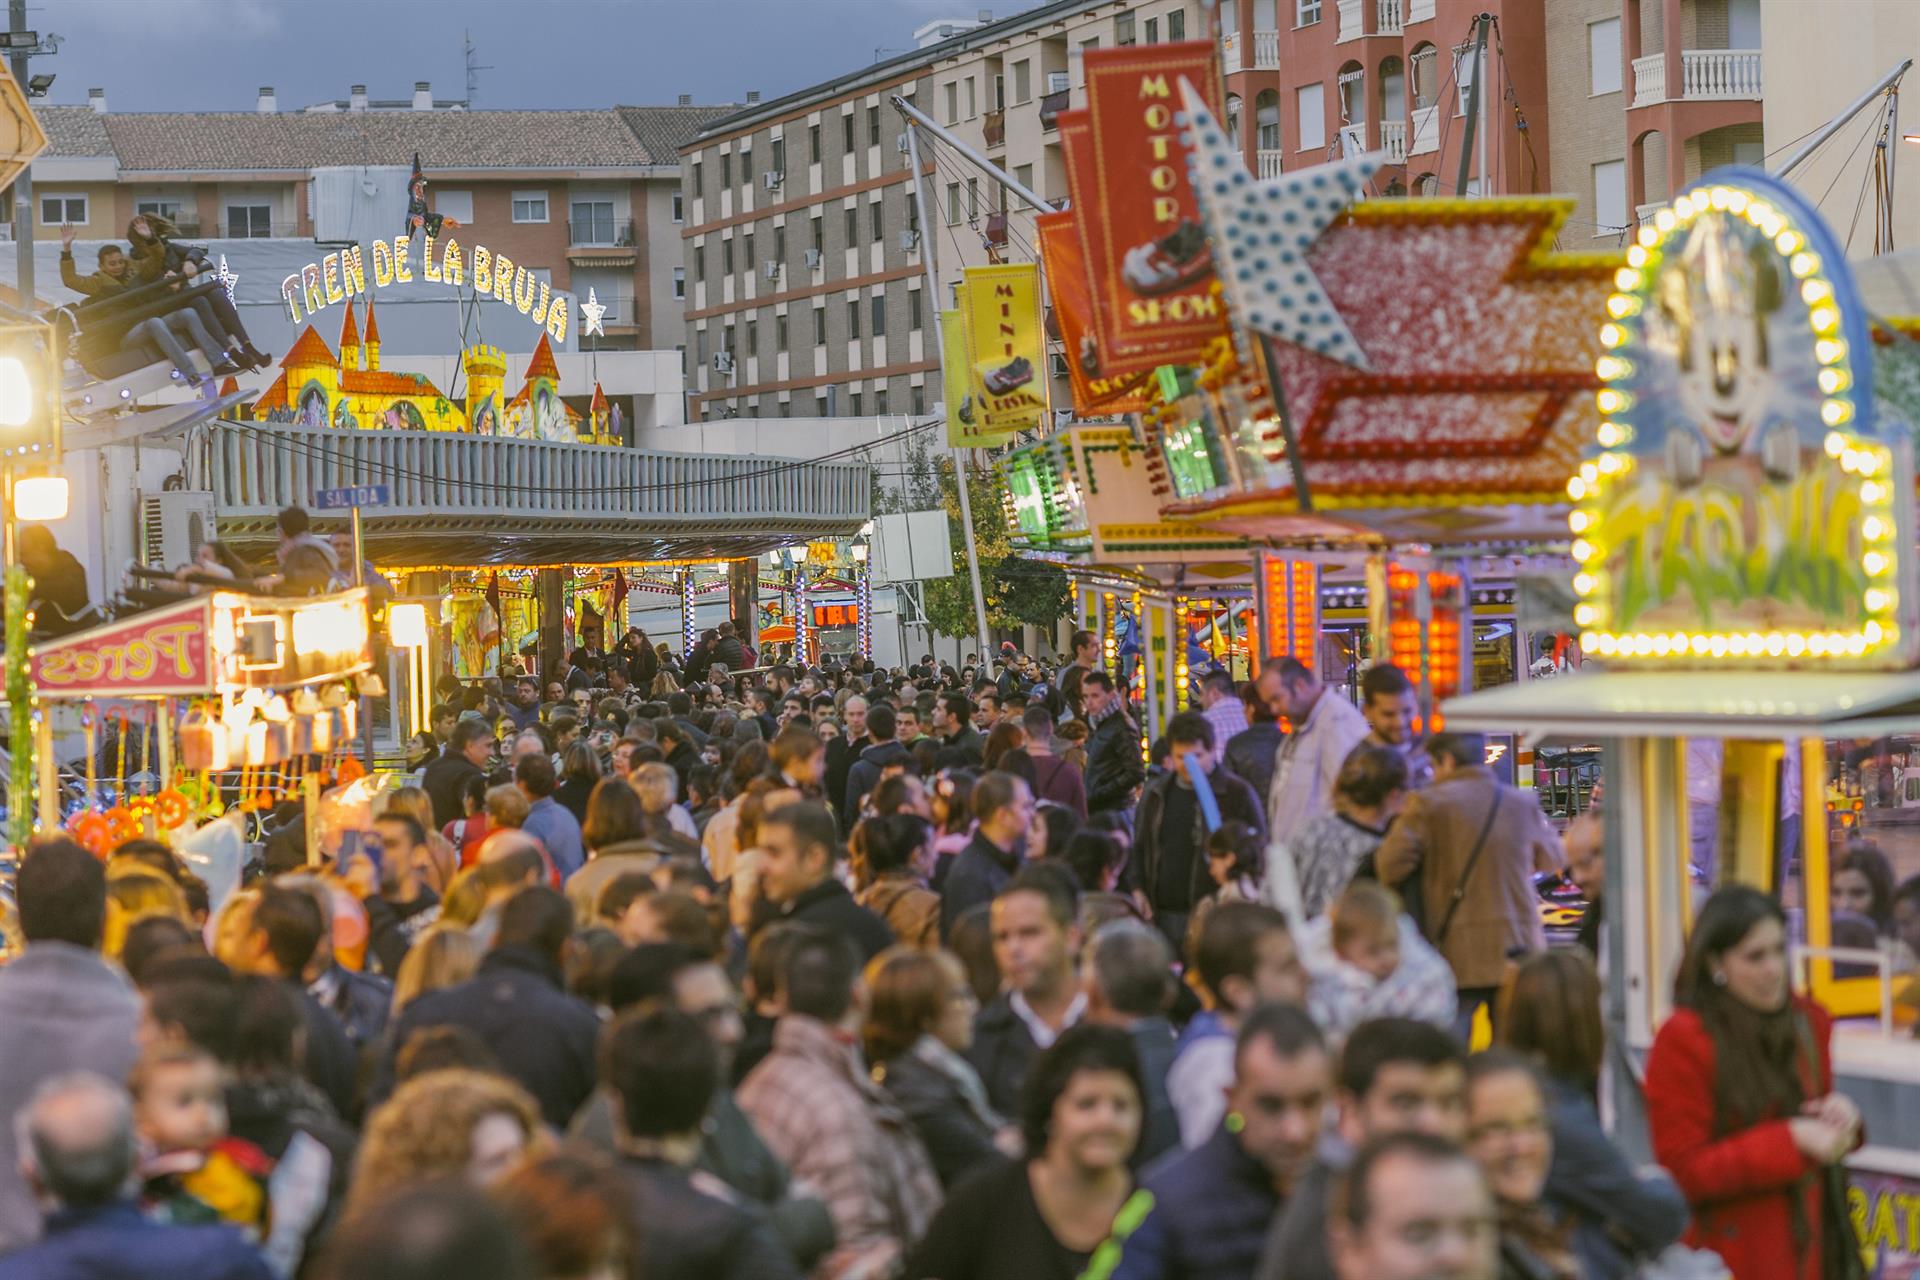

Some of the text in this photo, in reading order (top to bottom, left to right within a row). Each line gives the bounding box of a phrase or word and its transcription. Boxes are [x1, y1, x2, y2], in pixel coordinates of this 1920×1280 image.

[1139, 73, 1180, 223] MOTOR
[281, 235, 568, 344] TREN DE LA BRUJA
[995, 283, 1016, 357] MINI
[1127, 293, 1218, 327] SHOW
[326, 487, 379, 507] SALIDA
